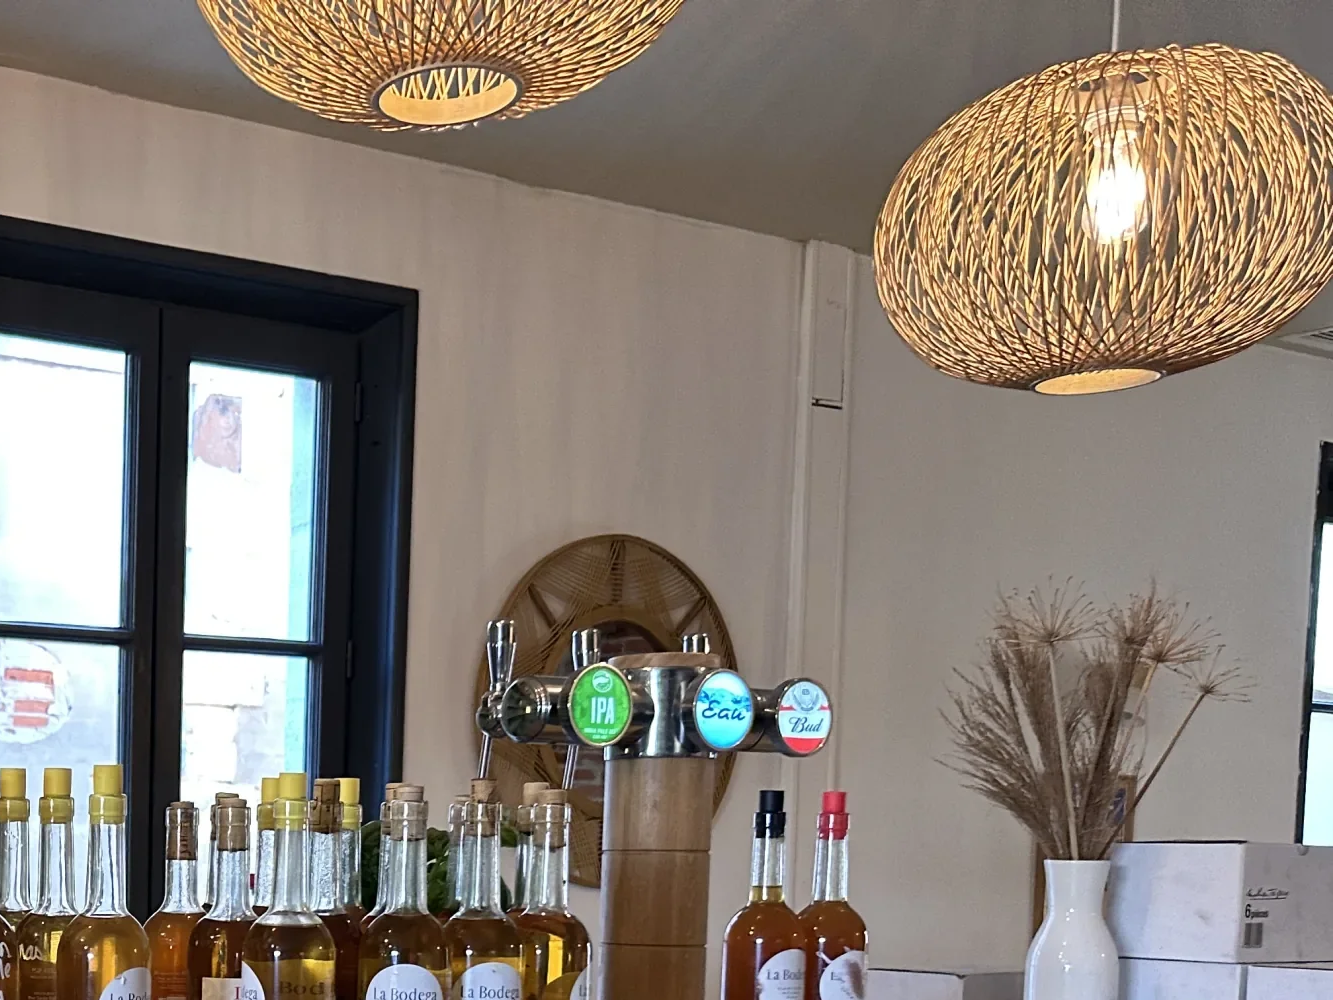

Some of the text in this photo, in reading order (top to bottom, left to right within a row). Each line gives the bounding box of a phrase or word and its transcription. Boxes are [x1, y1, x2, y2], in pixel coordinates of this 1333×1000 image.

[590, 695, 615, 725] IPA
[702, 699, 746, 721] Eau
[788, 716, 824, 734] Bud
[1245, 903, 1252, 918] 6
[767, 969, 781, 982] La
[373, 987, 386, 1000] La
[460, 985, 474, 1000] La
